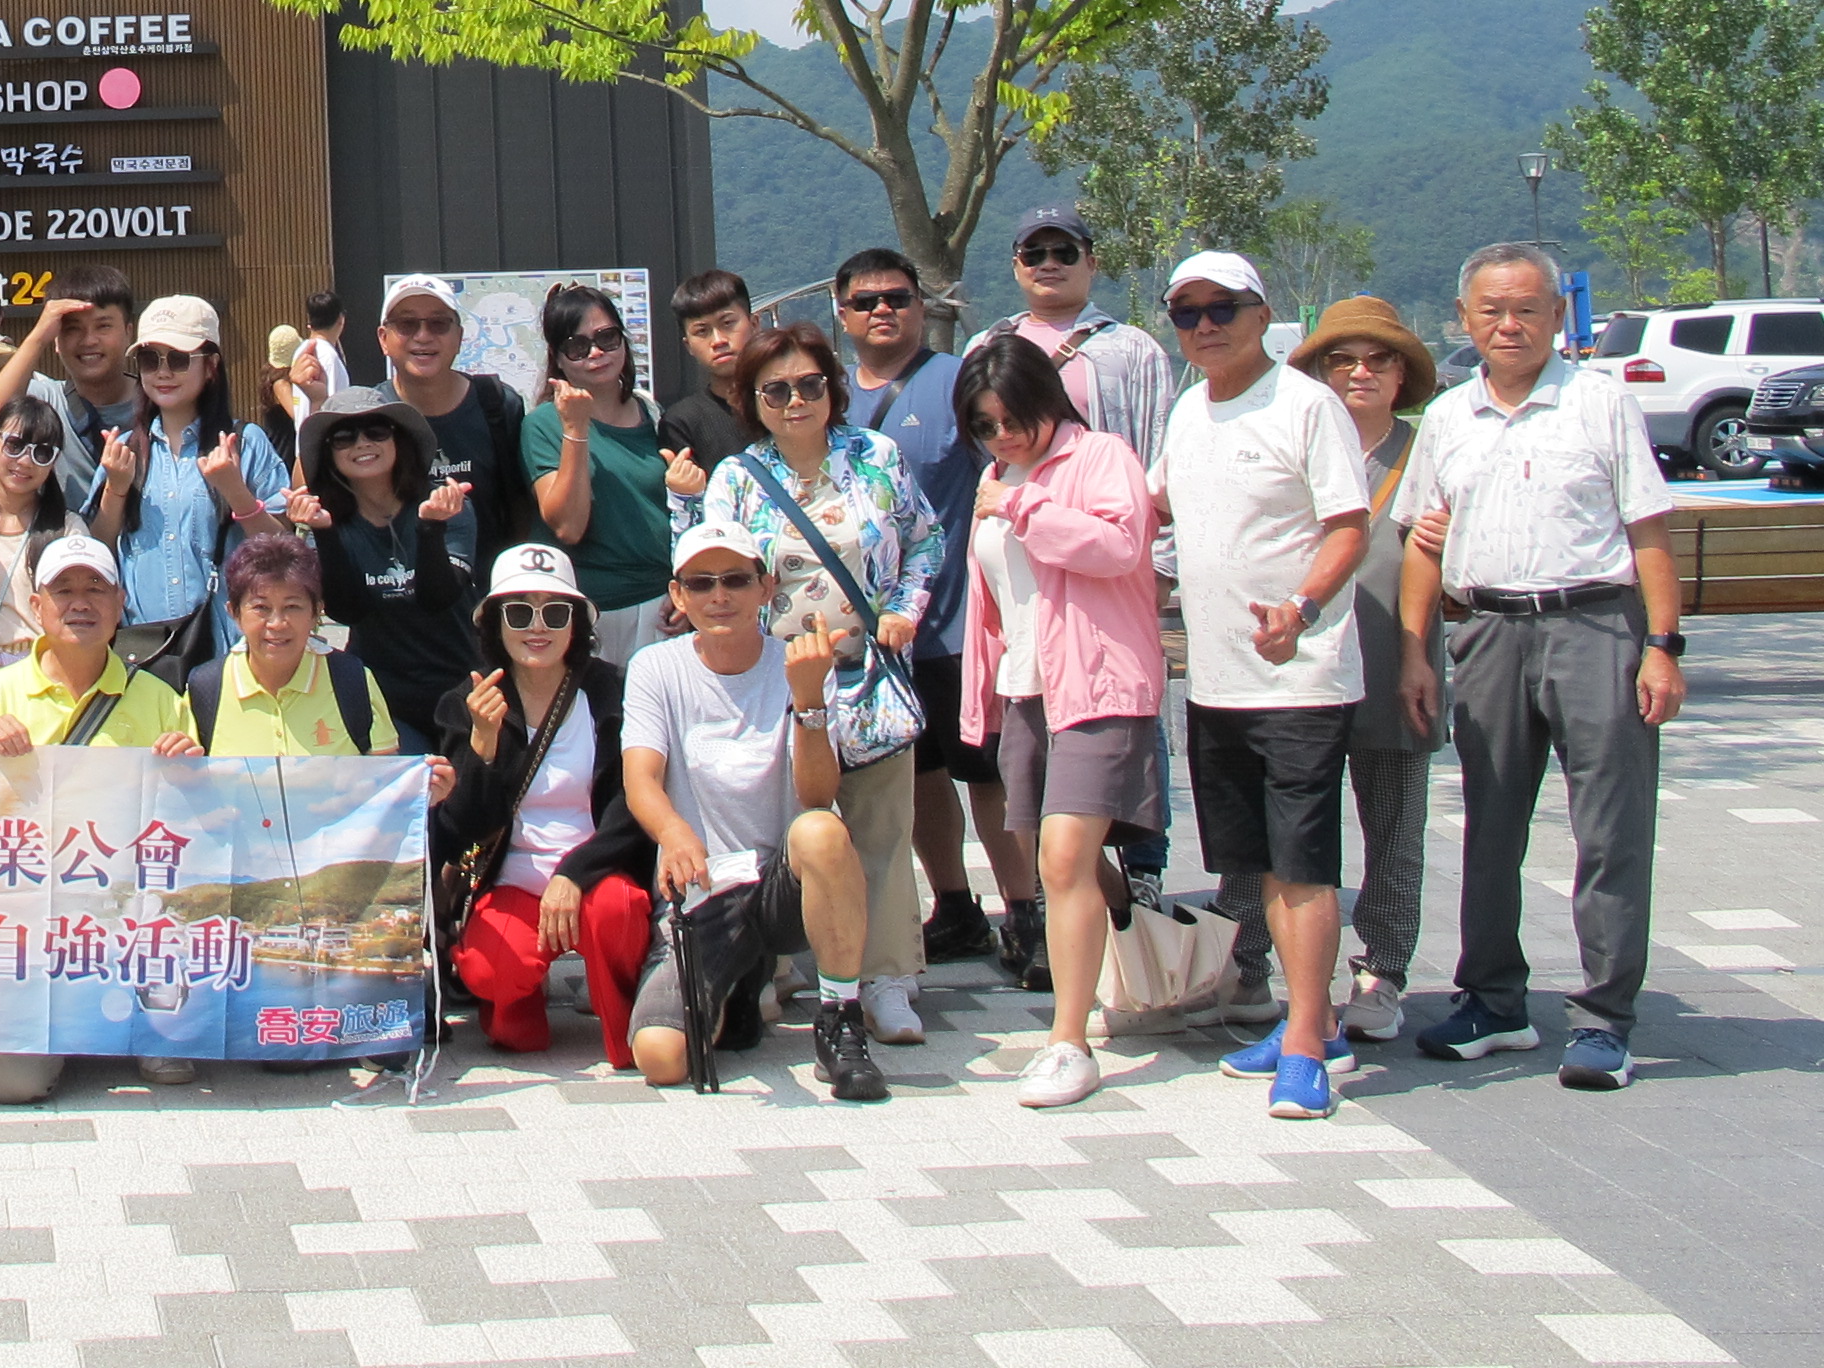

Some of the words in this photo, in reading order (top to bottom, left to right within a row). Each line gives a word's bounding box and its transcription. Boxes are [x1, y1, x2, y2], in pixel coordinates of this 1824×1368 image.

[23, 14, 192, 47] COFFEE
[0, 143, 84, 176] 막국수
[113, 158, 189, 171] 막국수전문점
[47, 205, 192, 240] 220VOLT
[1237, 449, 1260, 459] FILA
[439, 460, 472, 475] sportif
[365, 572, 376, 586] le
[256, 999, 409, 1046] 喬安旅遊
